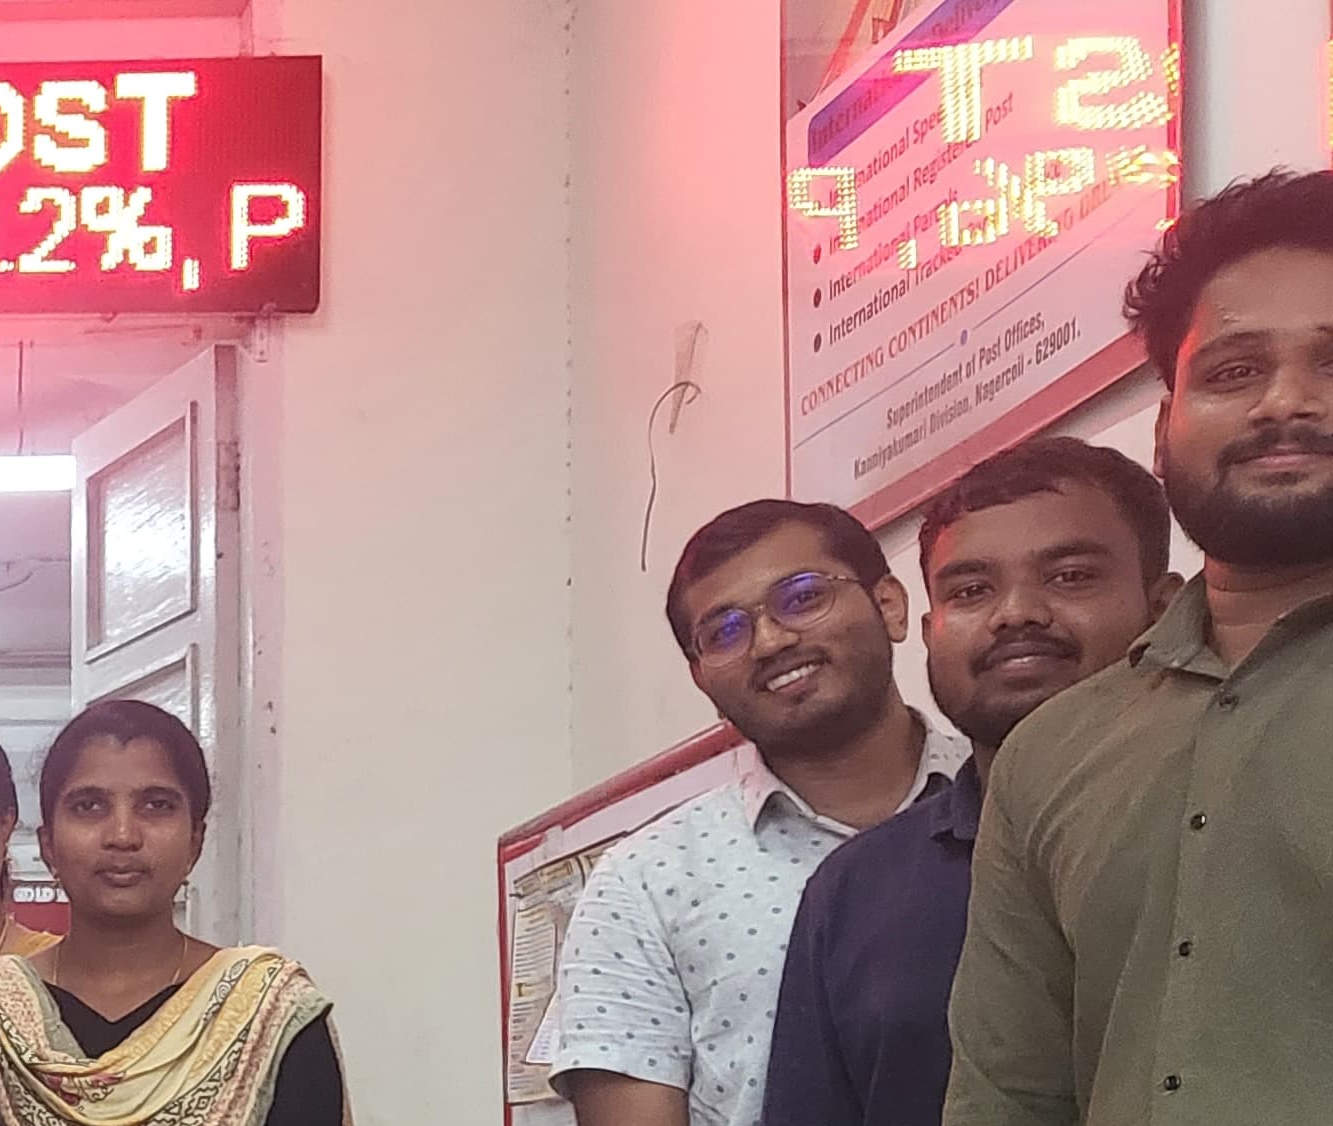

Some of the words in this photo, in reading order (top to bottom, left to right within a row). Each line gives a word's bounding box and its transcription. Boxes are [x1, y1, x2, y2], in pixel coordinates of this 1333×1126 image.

[984, 92, 1015, 133] Post
[230, 182, 306, 271] P
[830, 222, 911, 301] International
[801, 343, 885, 417] CONNECTING
[888, 283, 981, 359] CONTINENTS!
[830, 268, 911, 347] International
[853, 420, 928, 480] Kanniyakumari
[929, 394, 973, 438] Division,
[975, 361, 1025, 410] Nagercoil
[1035, 315, 1082, 368] 629001.
[885, 366, 964, 430] Superintendent
[965, 356, 977, 378] of
[979, 338, 1001, 372] Post
[1004, 311, 1046, 352] Offices,
